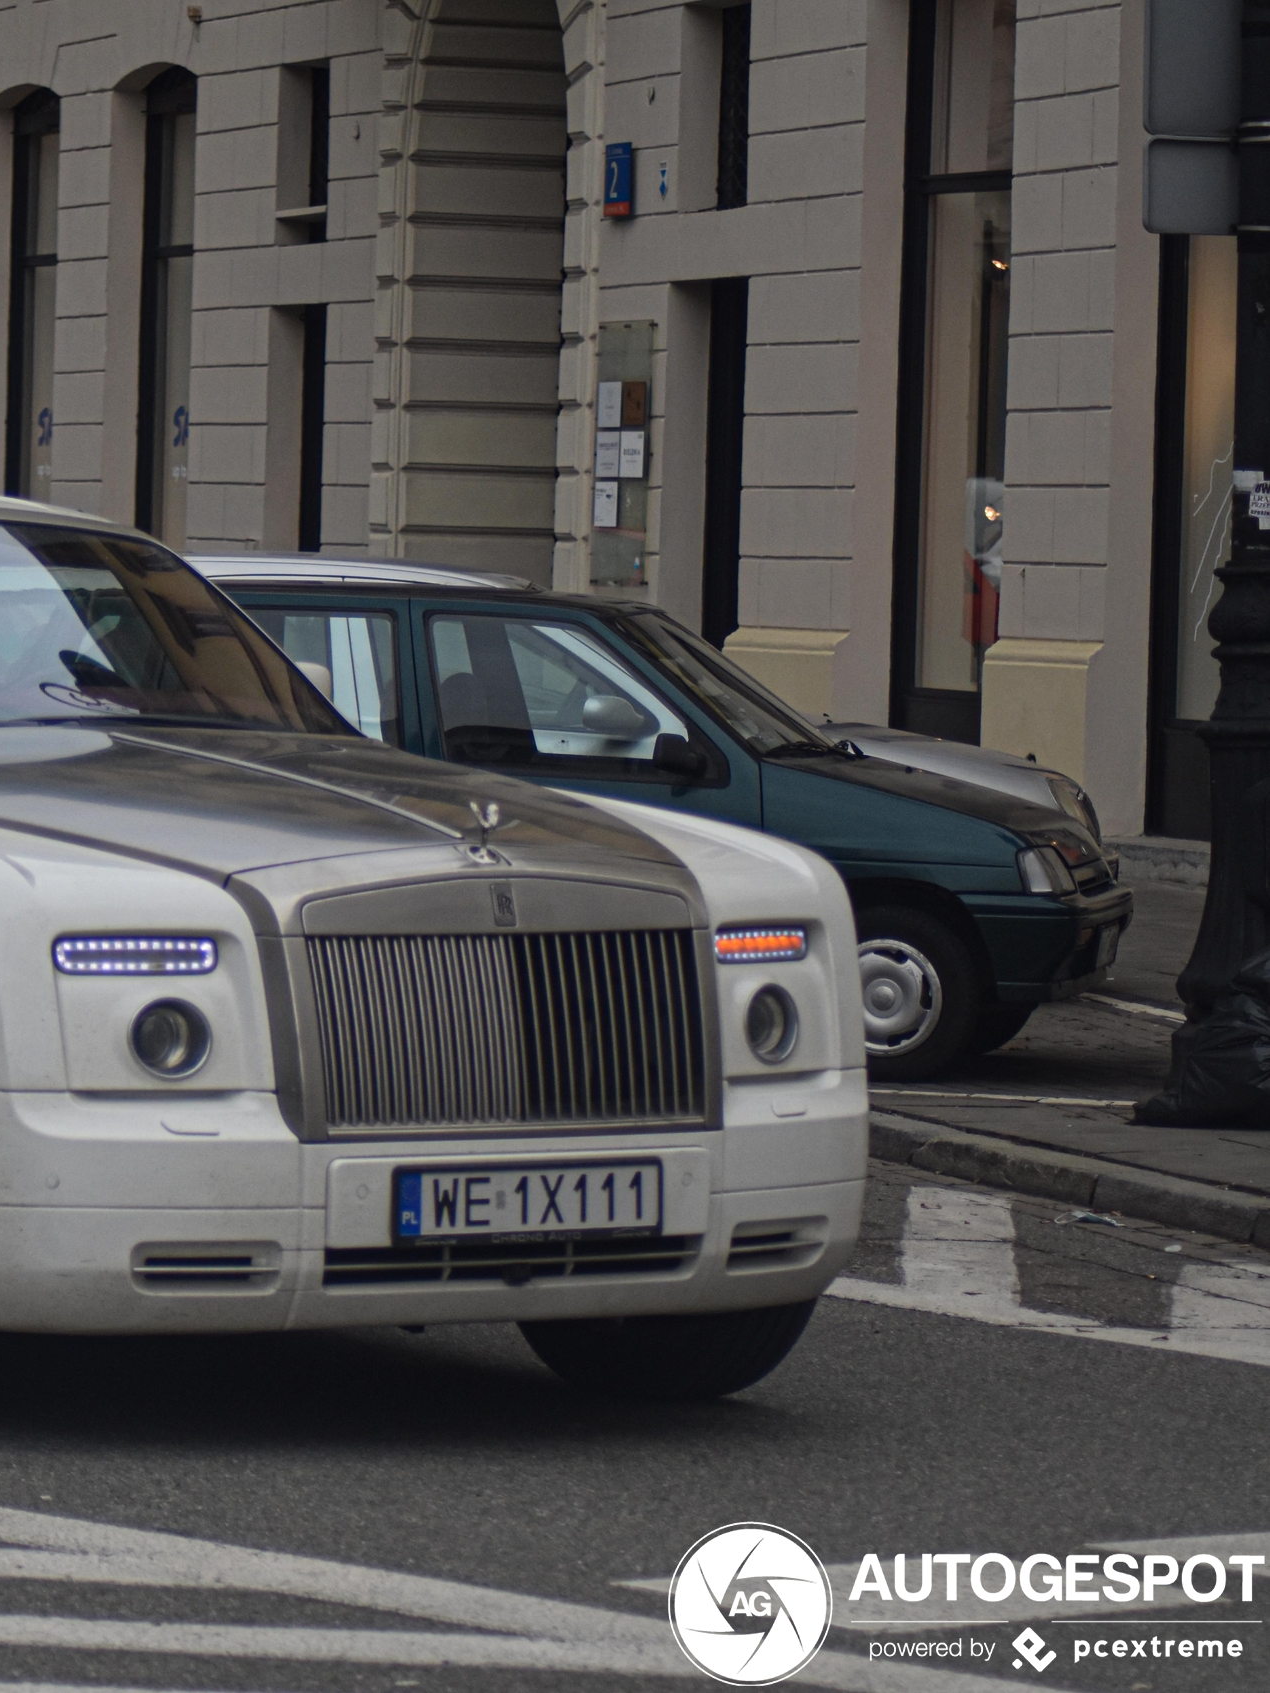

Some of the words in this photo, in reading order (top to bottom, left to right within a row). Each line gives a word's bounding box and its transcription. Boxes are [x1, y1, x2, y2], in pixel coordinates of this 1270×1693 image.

[610, 162, 618, 198] 2
[402, 1210, 418, 1225] PL
[432, 1177, 491, 1228] WE
[514, 1171, 643, 1225] 1X111
